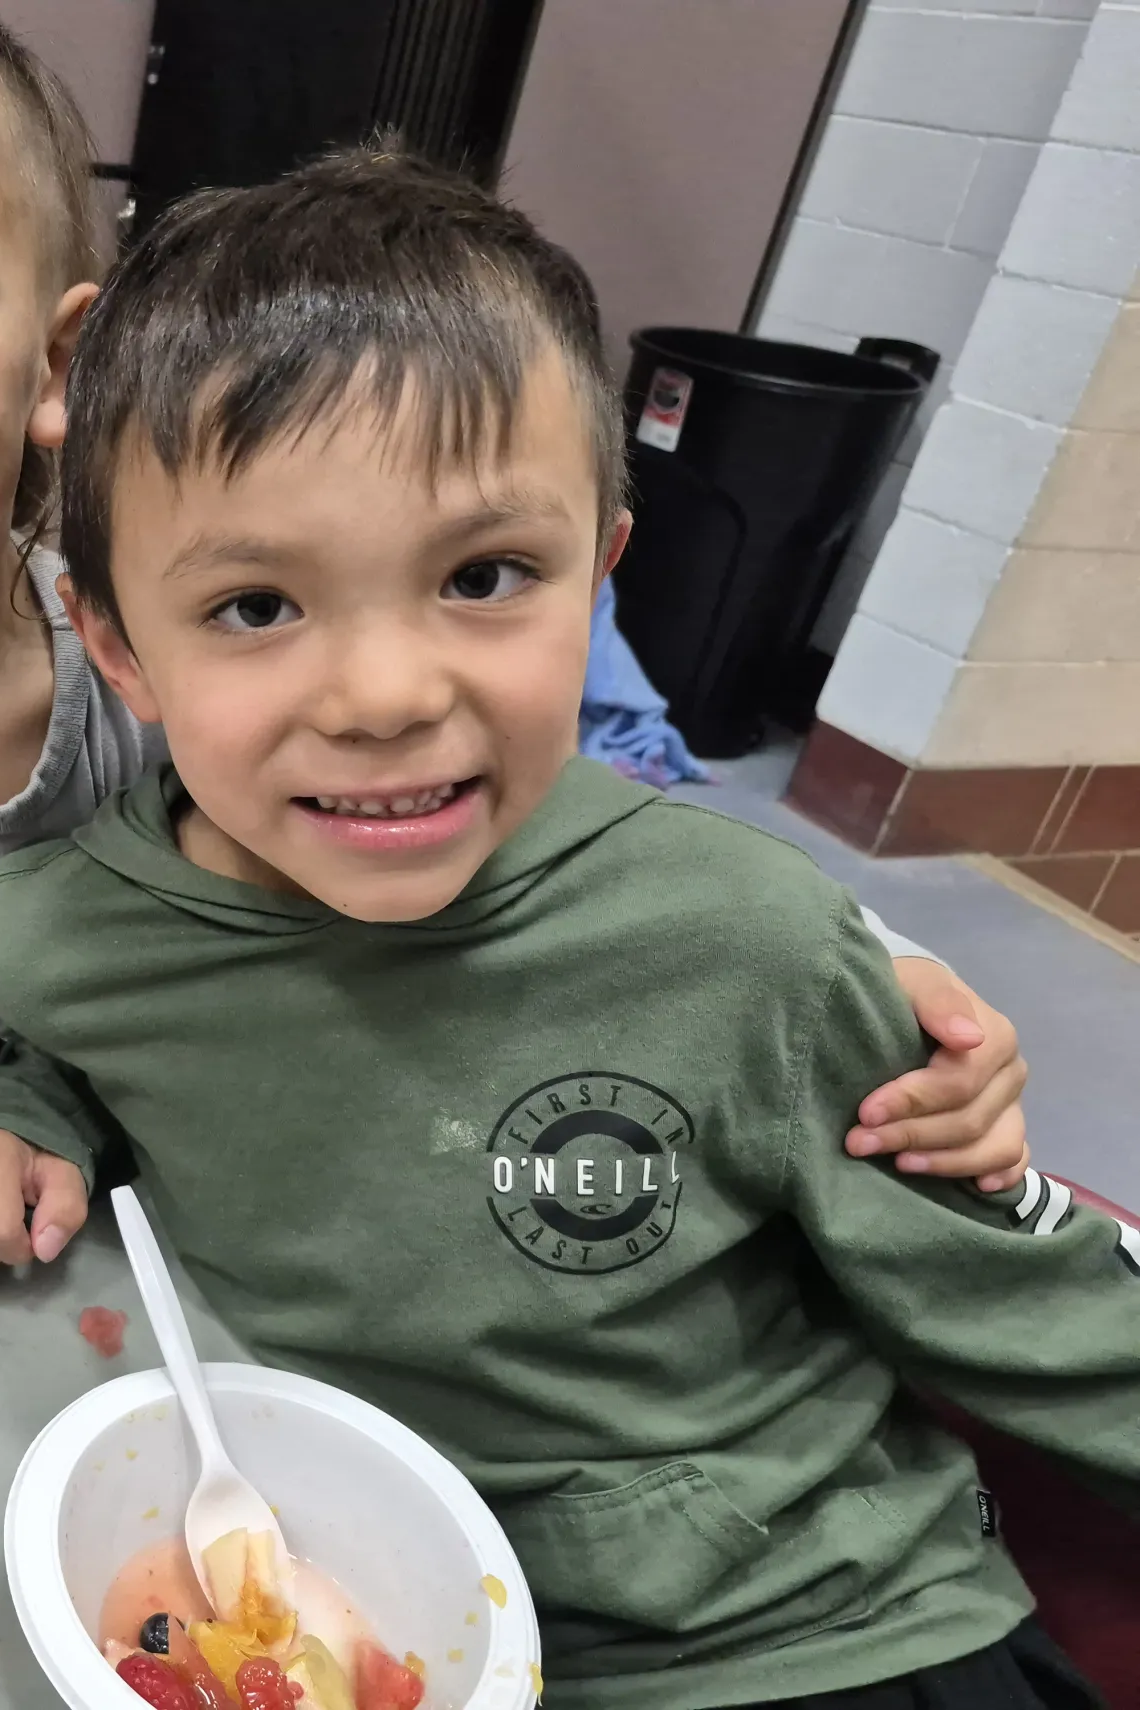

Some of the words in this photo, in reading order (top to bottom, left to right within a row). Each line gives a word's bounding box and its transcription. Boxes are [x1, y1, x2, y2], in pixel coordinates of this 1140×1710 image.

[508, 1084, 621, 1144] FIRST
[651, 1109, 684, 1144] IN
[508, 1206, 592, 1264] LAST
[625, 1200, 671, 1254] OUT
